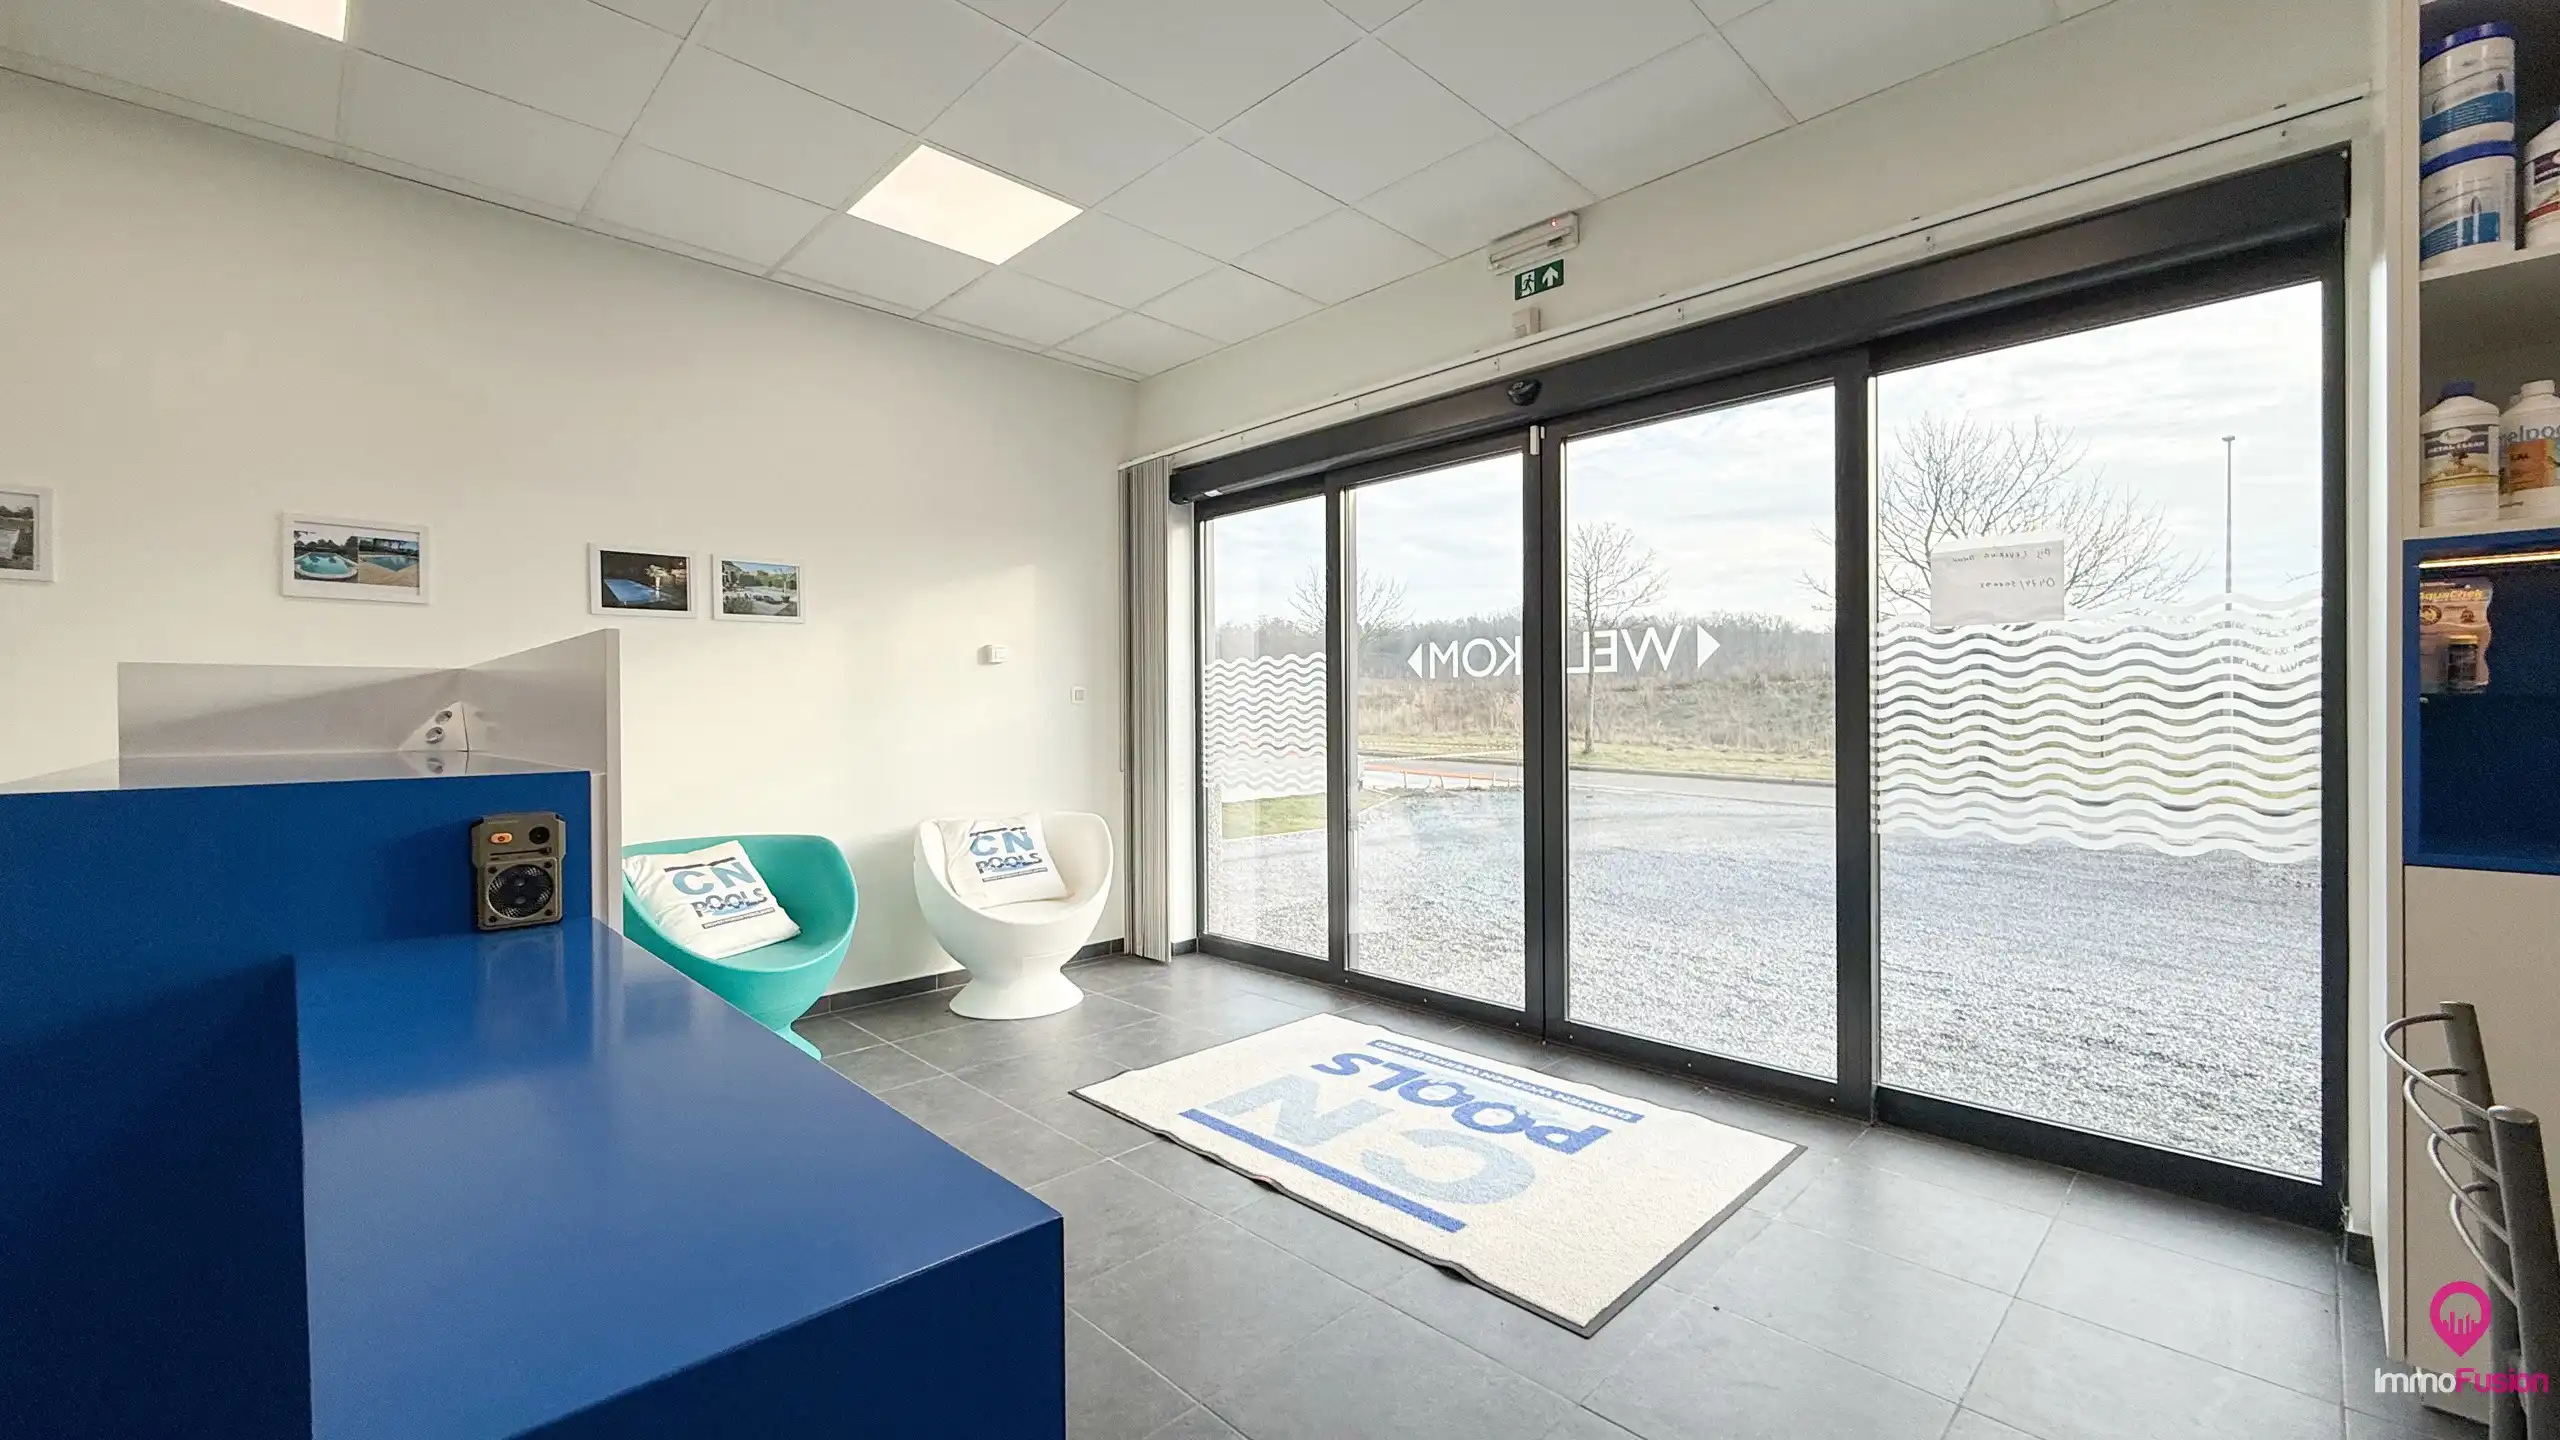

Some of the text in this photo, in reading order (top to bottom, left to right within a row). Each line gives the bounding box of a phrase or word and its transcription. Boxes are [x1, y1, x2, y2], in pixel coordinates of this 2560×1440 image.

[970, 831, 1035, 857] CN
[672, 861, 757, 896] CN
[975, 852, 1043, 874] POOLS
[691, 887, 769, 918] POOLS
[1310, 1051, 1613, 1156] POOLS
[1204, 1071, 1537, 1205] CN
